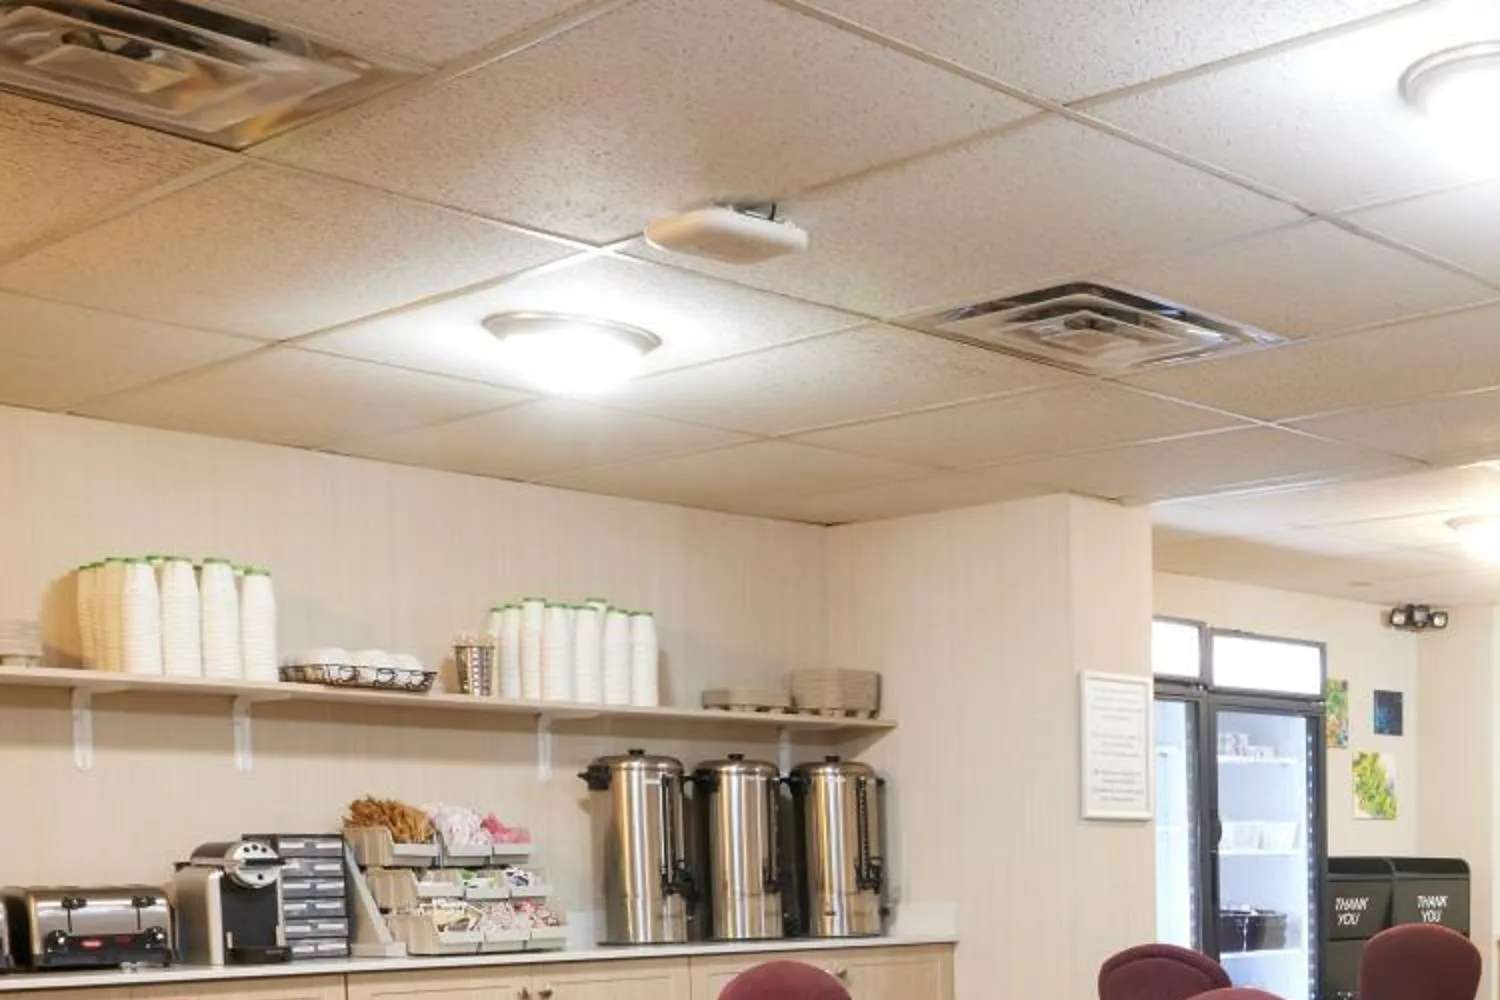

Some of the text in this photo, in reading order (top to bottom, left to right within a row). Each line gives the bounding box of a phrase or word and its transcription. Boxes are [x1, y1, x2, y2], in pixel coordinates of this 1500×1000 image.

[1335, 897, 1369, 910] THANK
[1417, 895, 1449, 908] THANK
[1338, 912, 1360, 926] YOU
[1422, 910, 1442, 923] YOU
